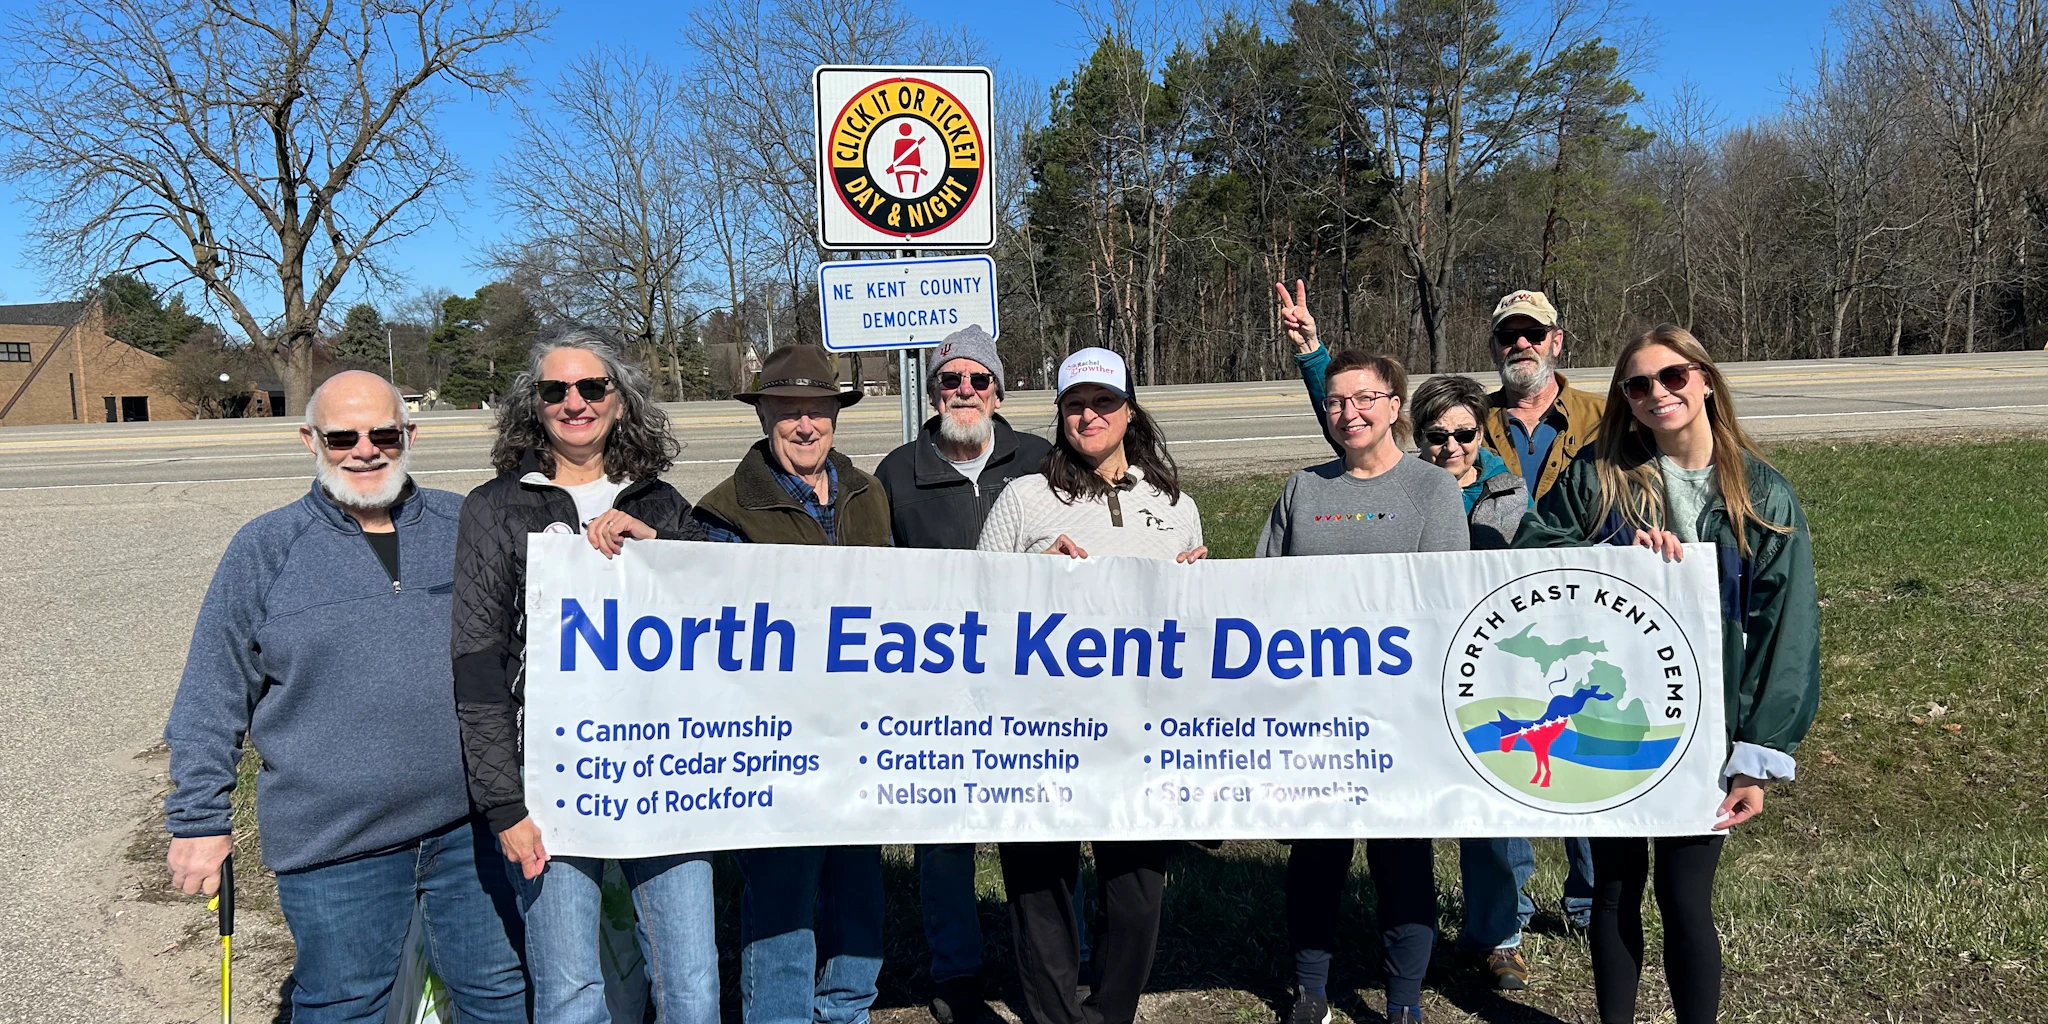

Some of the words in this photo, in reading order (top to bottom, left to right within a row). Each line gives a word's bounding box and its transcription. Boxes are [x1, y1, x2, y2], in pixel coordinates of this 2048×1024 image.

[836, 102, 876, 162] CLICK
[871, 89, 891, 115] IT
[898, 86, 925, 111] OR
[929, 95, 976, 161] TICKET
[845, 175, 886, 216] DAY
[887, 202, 901, 227] &
[907, 175, 968, 227] NIGHT
[833, 283, 854, 300] NE
[867, 281, 906, 298] KENT
[920, 277, 981, 296] COUNTY
[863, 308, 958, 328] DEMOCRATS
[560, 598, 796, 672] North
[826, 606, 987, 674] East
[1014, 611, 1186, 680] Kent
[1211, 617, 1413, 680] Dems
[1459, 611, 1506, 697] NORTH
[1510, 584, 1580, 613] EAST
[1594, 588, 1661, 635] KENT
[1656, 645, 1684, 719] DEMS
[576, 718, 670, 743] Cannon
[678, 715, 793, 741] Township
[878, 715, 993, 736] Courtland
[1000, 716, 1109, 741] Township
[1160, 717, 1255, 737] Oakfield
[1263, 717, 1370, 741] Township
[576, 756, 626, 784] City
[633, 754, 655, 778] of
[659, 752, 727, 776] Cedar
[732, 749, 820, 777] Springs
[877, 749, 965, 770] Grattan
[972, 749, 1080, 773] Township
[1160, 749, 1271, 769] Plainfield
[1278, 750, 1393, 773] Township
[576, 793, 628, 821] City
[636, 791, 660, 815] of
[665, 785, 774, 812] Rockford
[877, 783, 956, 805] Nelson
